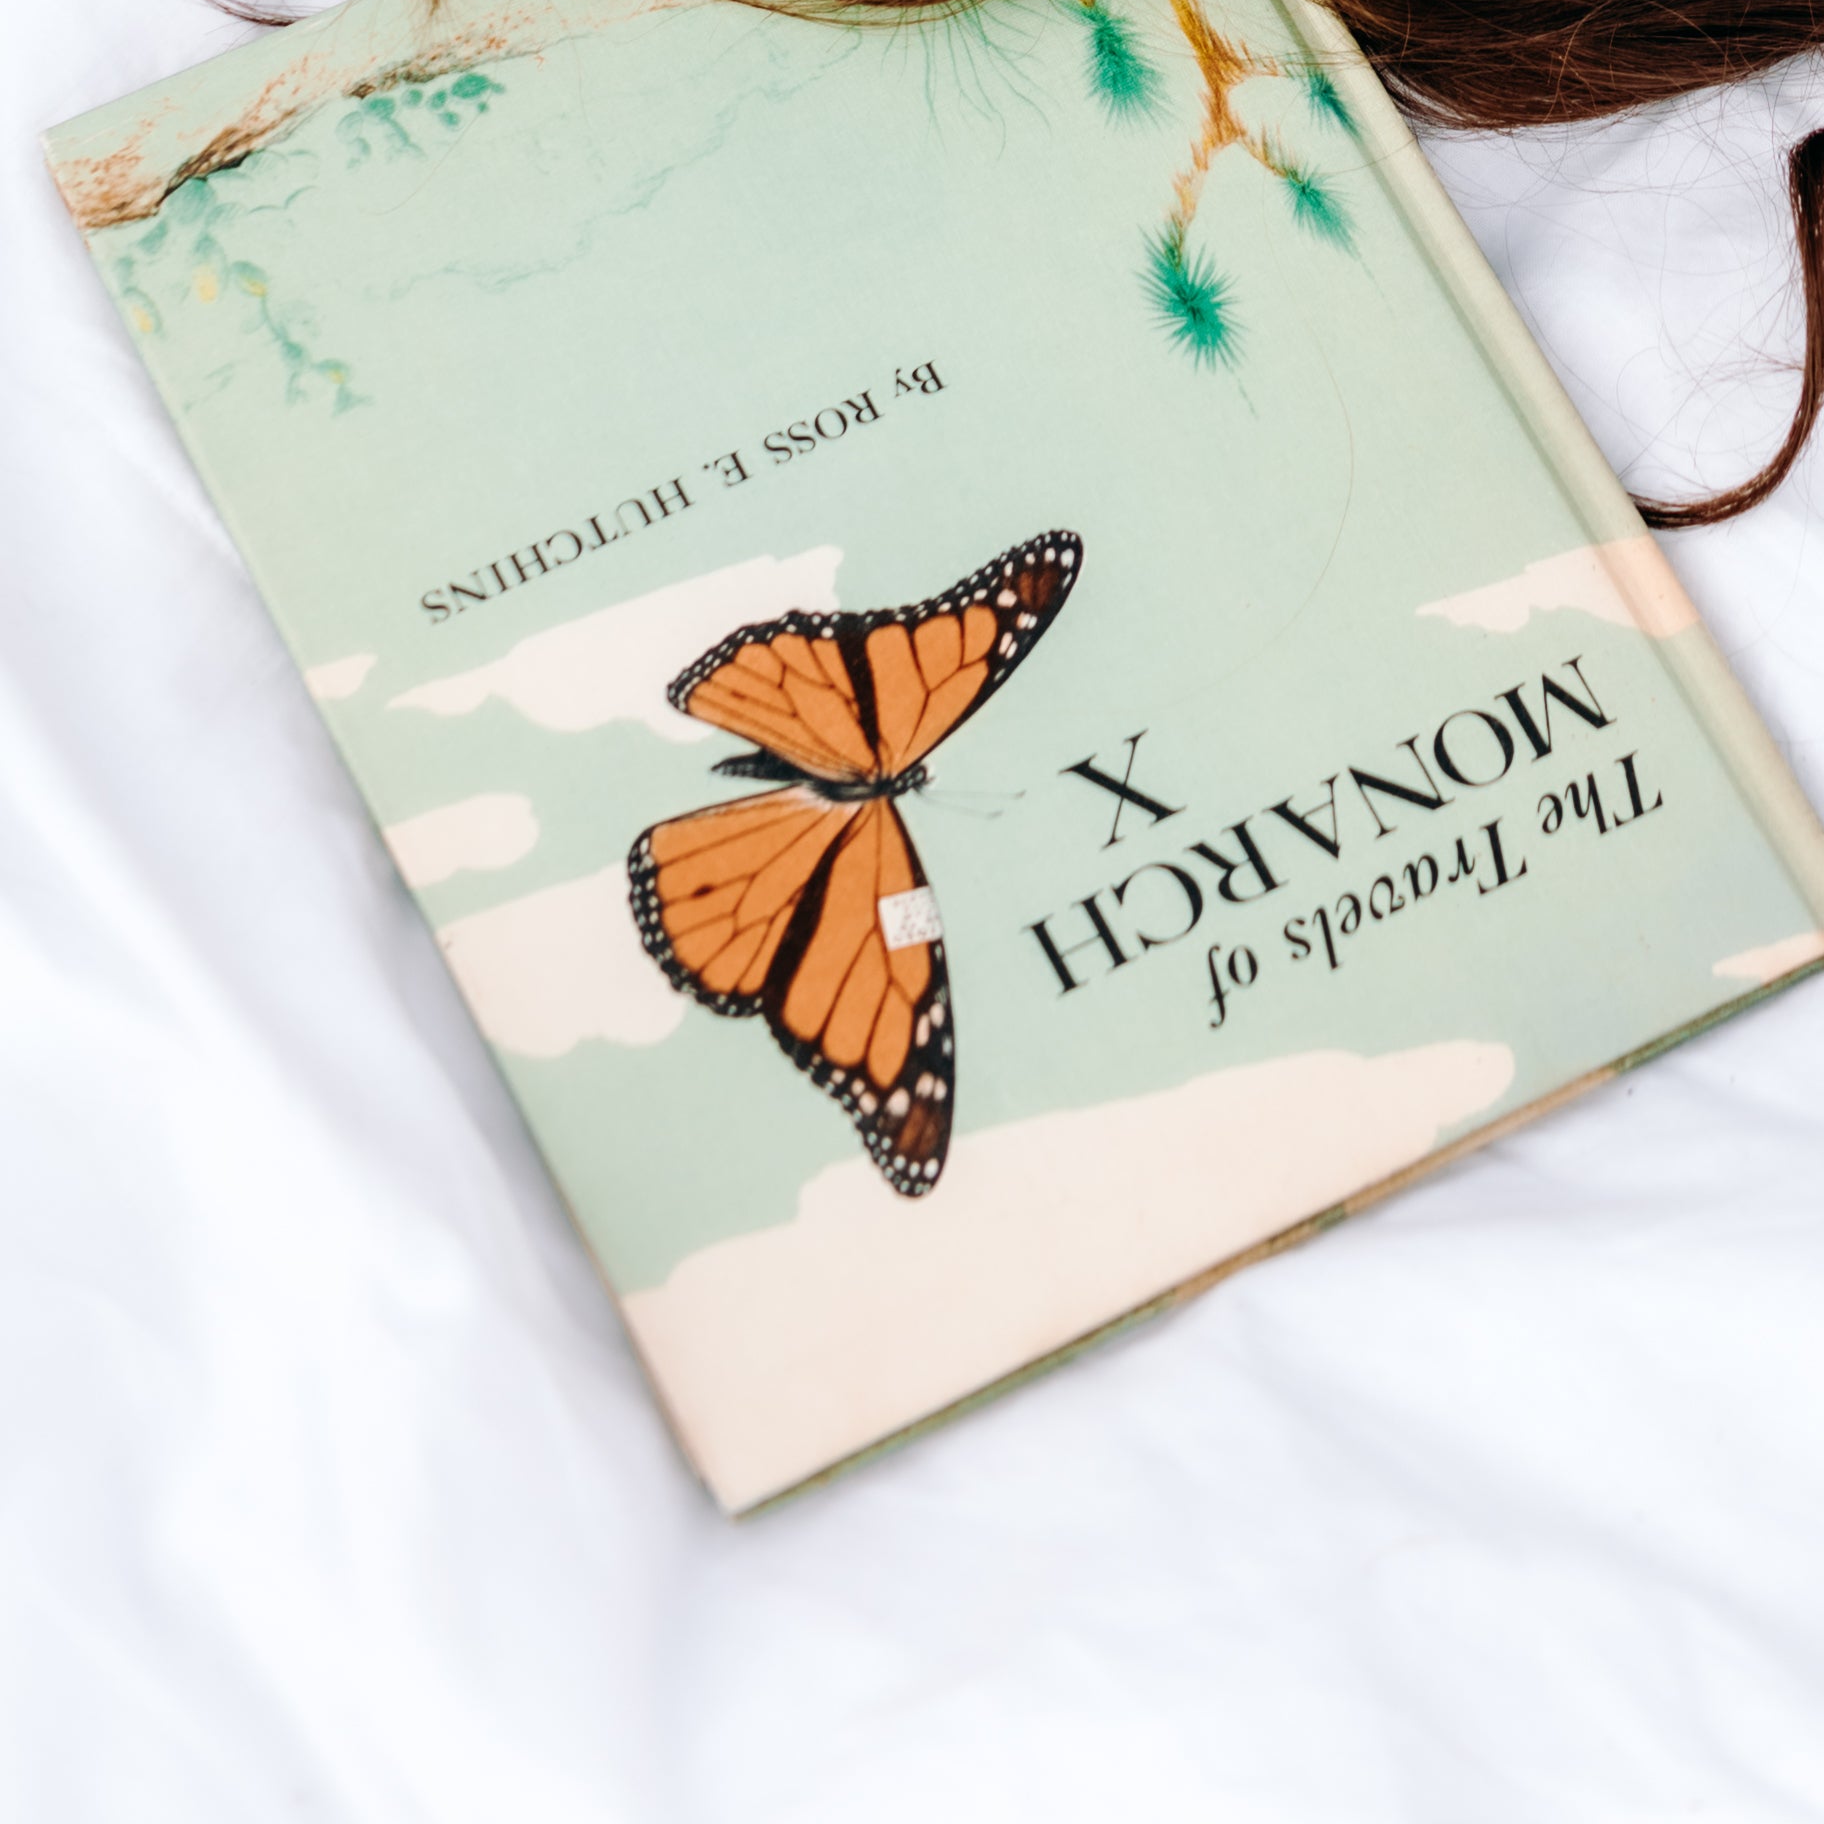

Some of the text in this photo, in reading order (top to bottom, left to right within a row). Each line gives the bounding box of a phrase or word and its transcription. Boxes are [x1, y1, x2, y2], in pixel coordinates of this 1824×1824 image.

[420, 360, 947, 625] By ROSS E. HUTCHINS
[1021, 655, 1617, 996] MONARCH
[1060, 729, 1186, 849] X
[1206, 749, 1664, 1030] The Travels of
